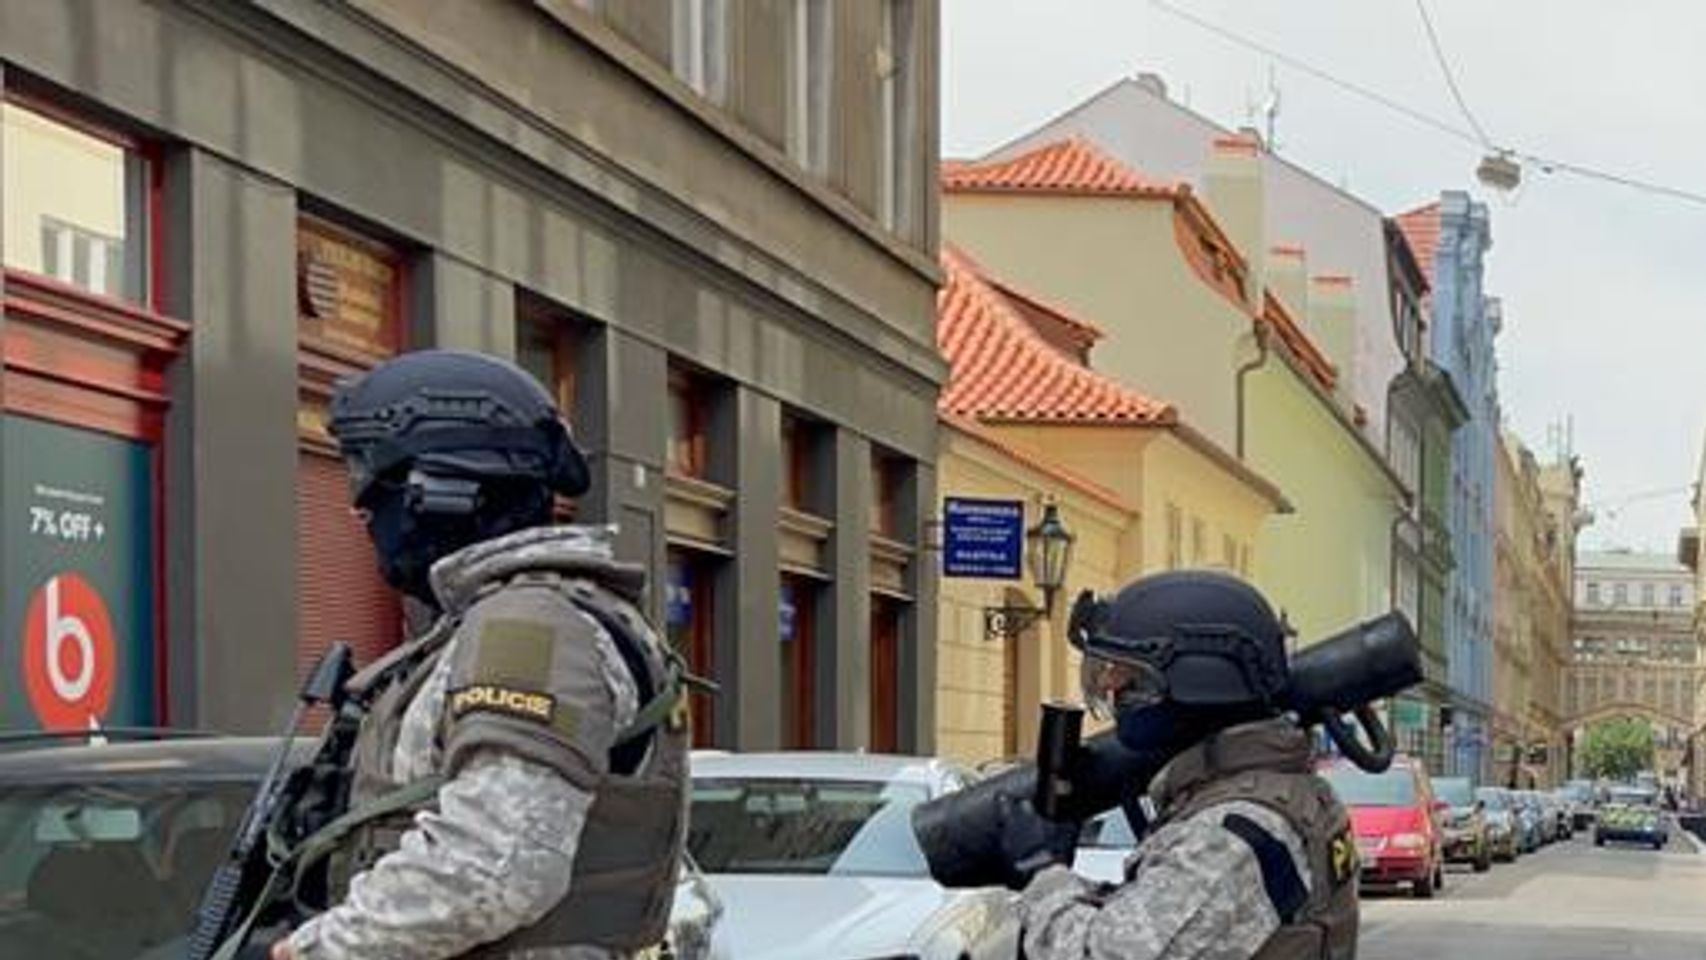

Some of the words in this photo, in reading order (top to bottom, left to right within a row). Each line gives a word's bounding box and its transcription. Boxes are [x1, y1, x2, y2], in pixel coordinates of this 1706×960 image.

[29, 506, 57, 535] 7%
[59, 510, 91, 541] OFF
[46, 575, 95, 702] b
